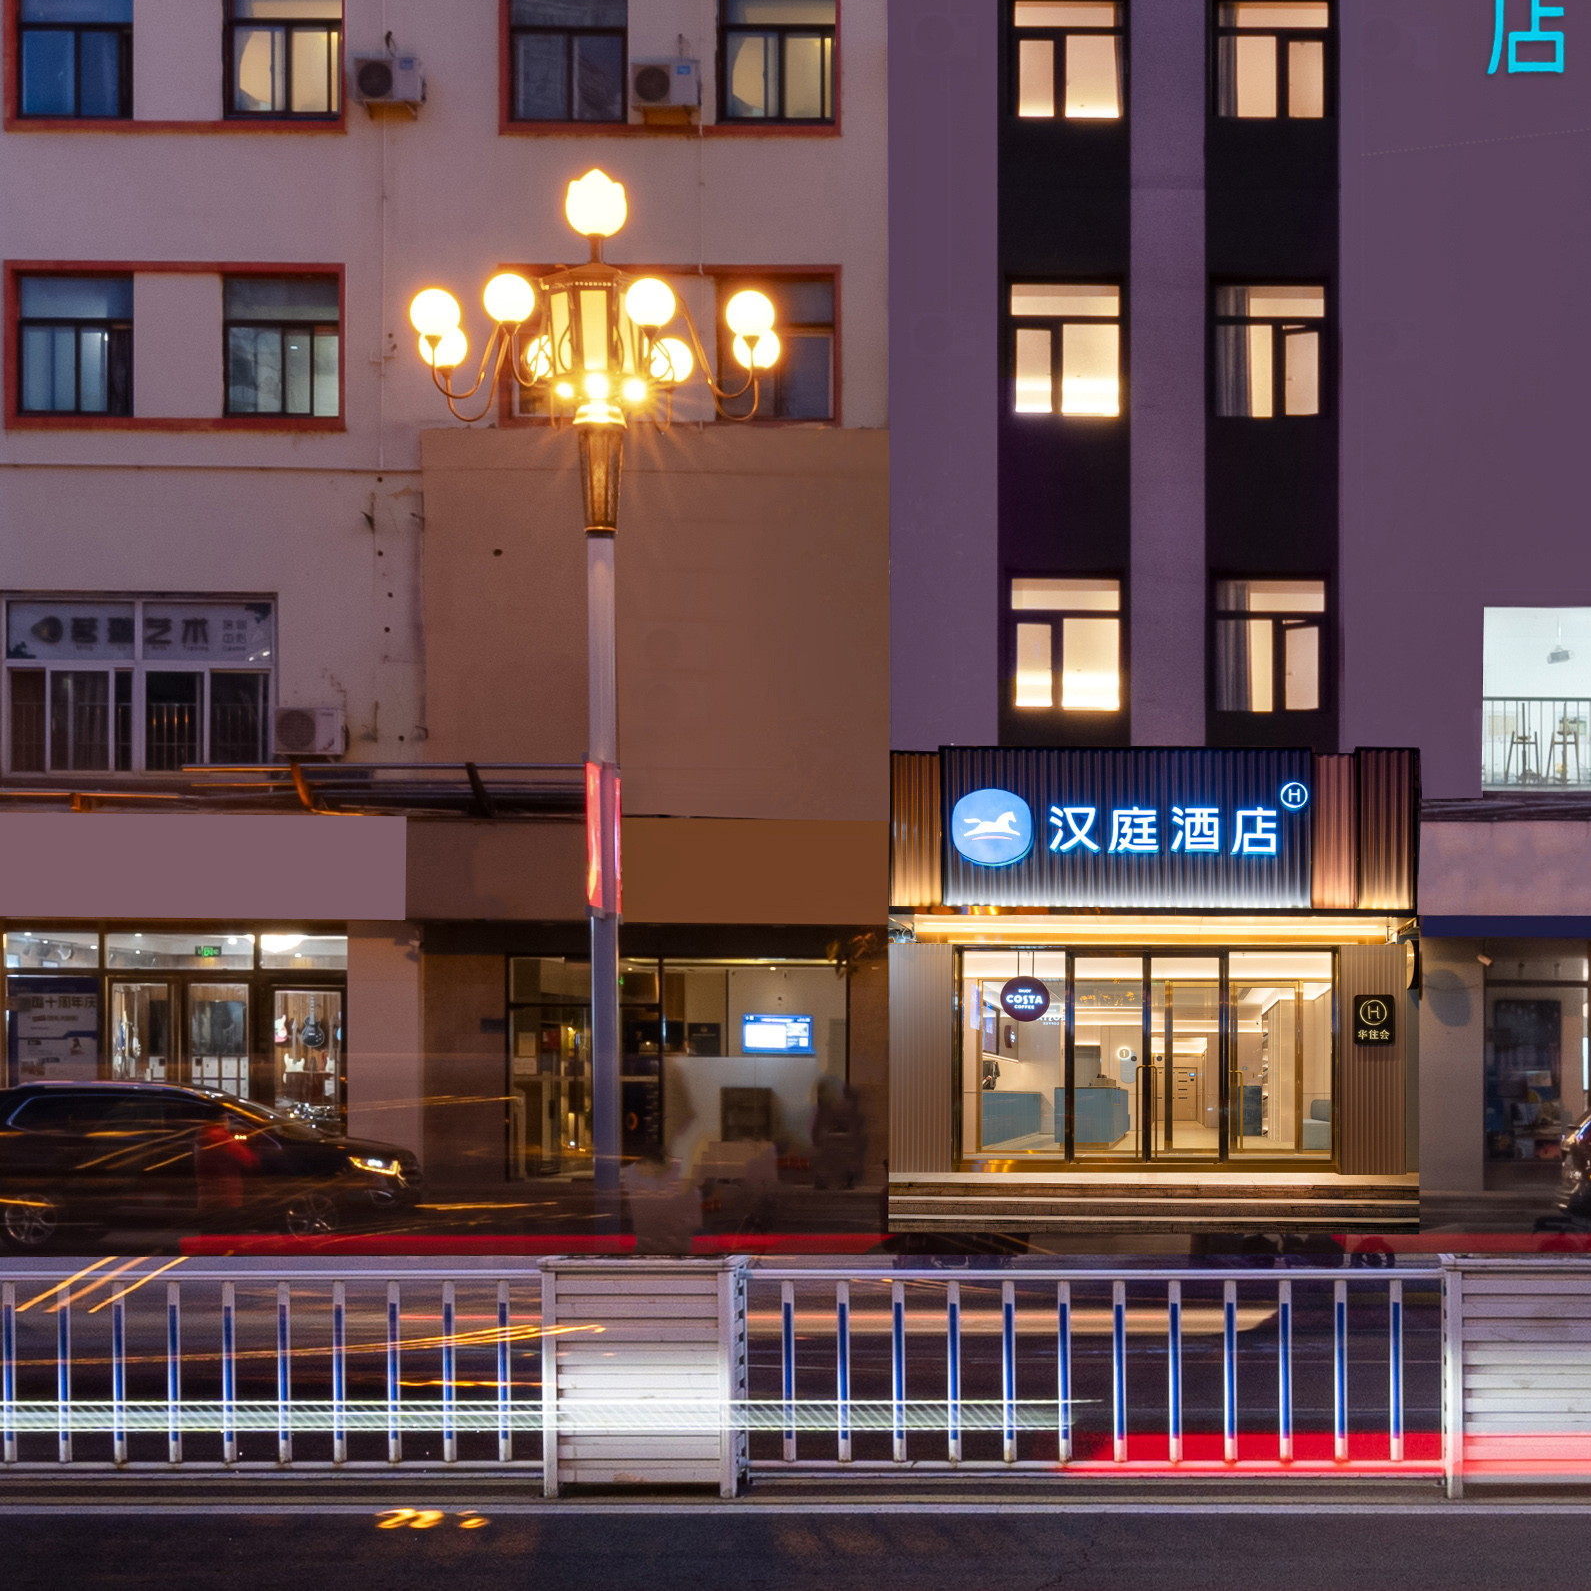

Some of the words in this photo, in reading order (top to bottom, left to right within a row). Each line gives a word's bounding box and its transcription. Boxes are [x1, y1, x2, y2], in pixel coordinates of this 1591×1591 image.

[1048, 805, 1279, 855] 汉庭酒店
[1005, 994, 1043, 1005] COSTA
[1357, 1029, 1390, 1040] 华住会
